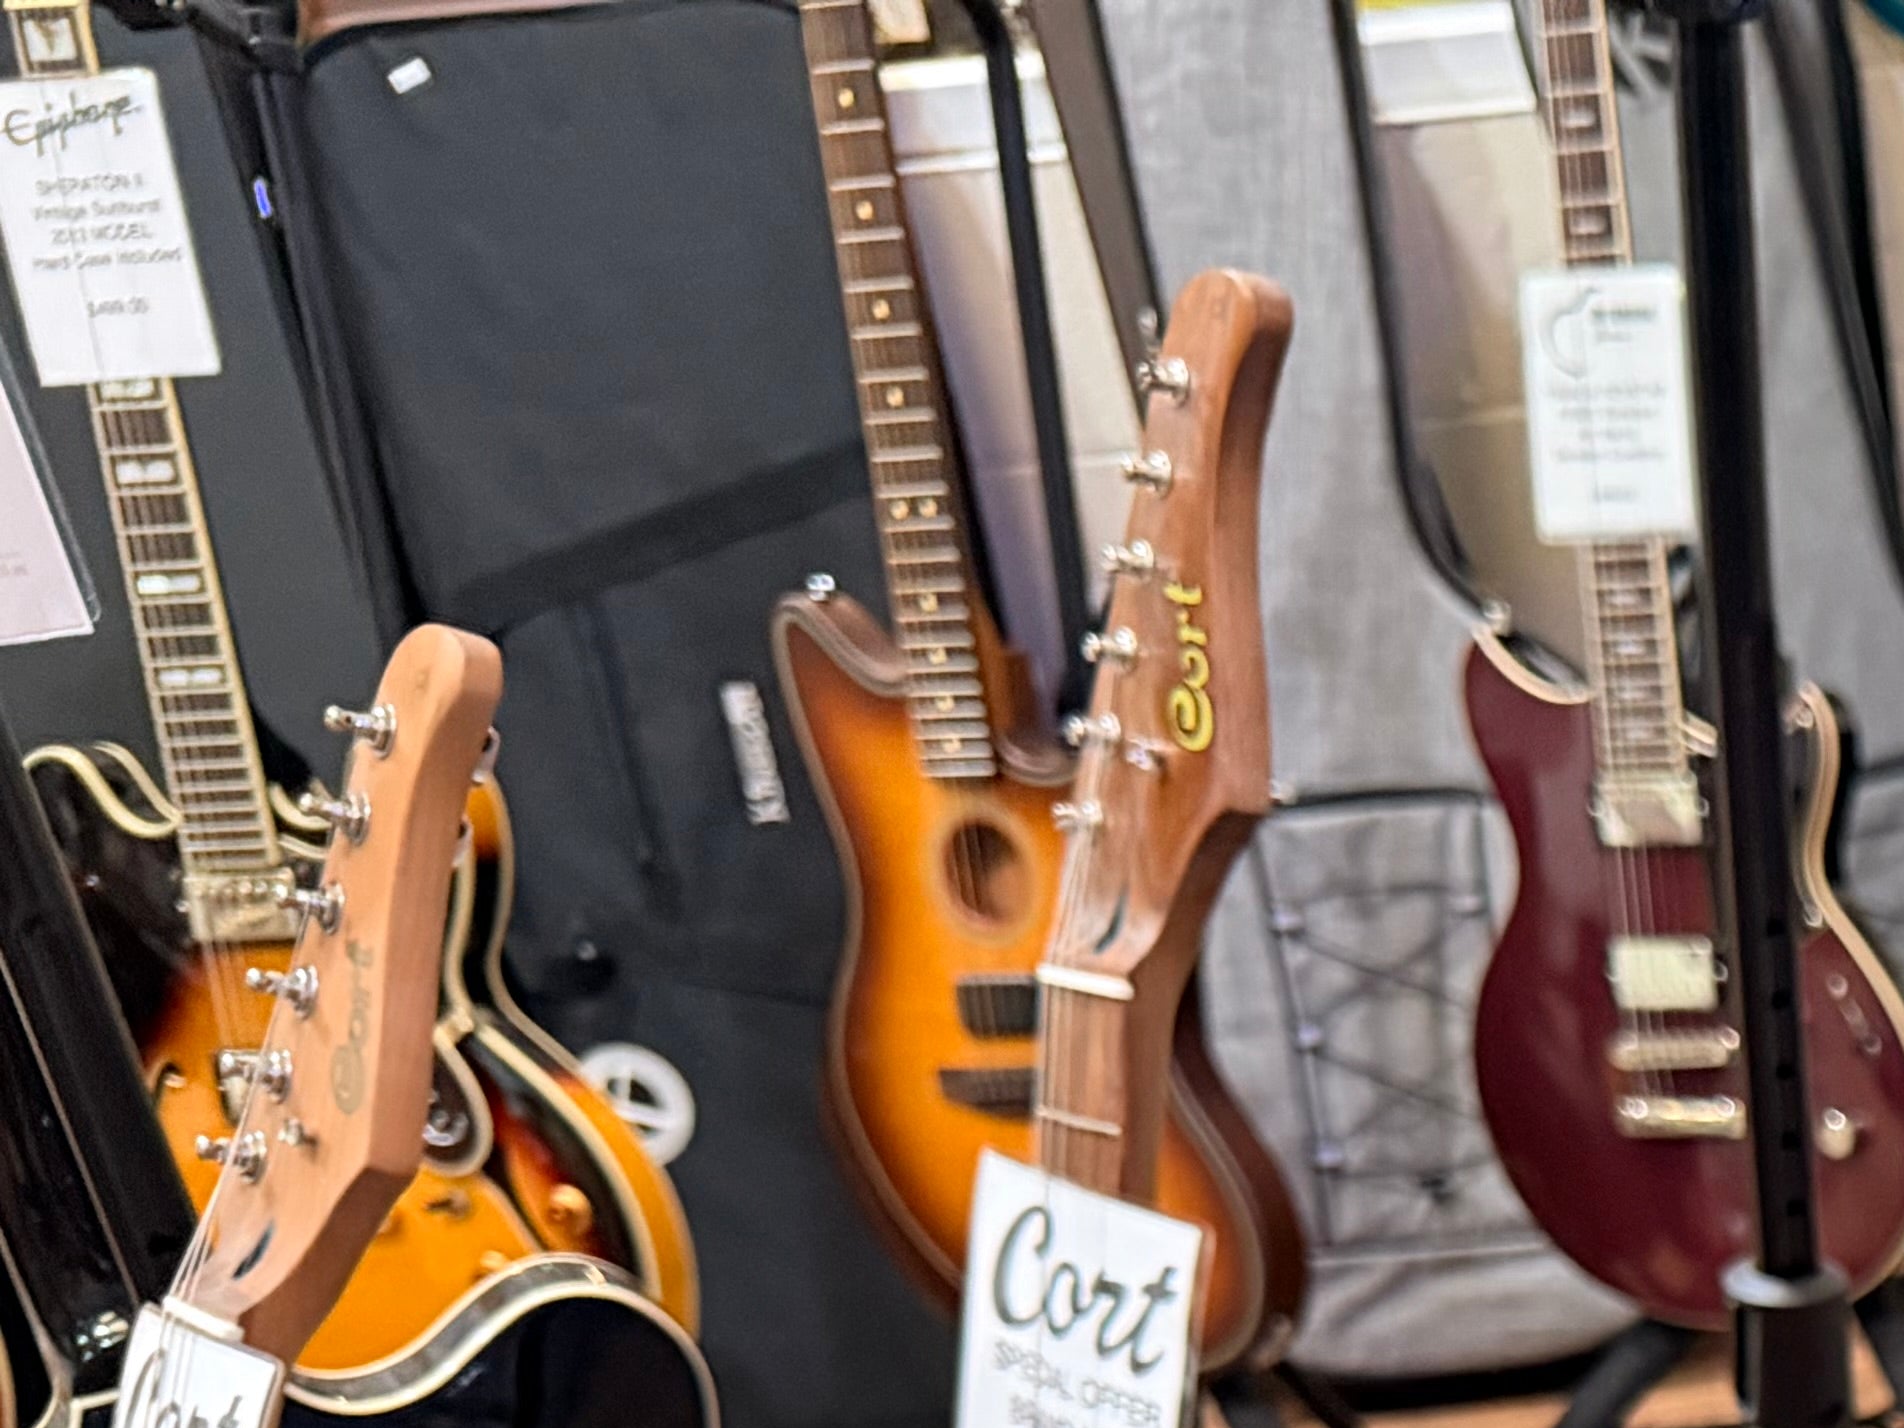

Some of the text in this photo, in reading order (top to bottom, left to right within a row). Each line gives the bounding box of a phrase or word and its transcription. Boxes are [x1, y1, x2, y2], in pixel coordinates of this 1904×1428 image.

[0, 89, 144, 158] Epiphone
[1163, 570, 1214, 752] Cort
[992, 1204, 1178, 1376] Cort
